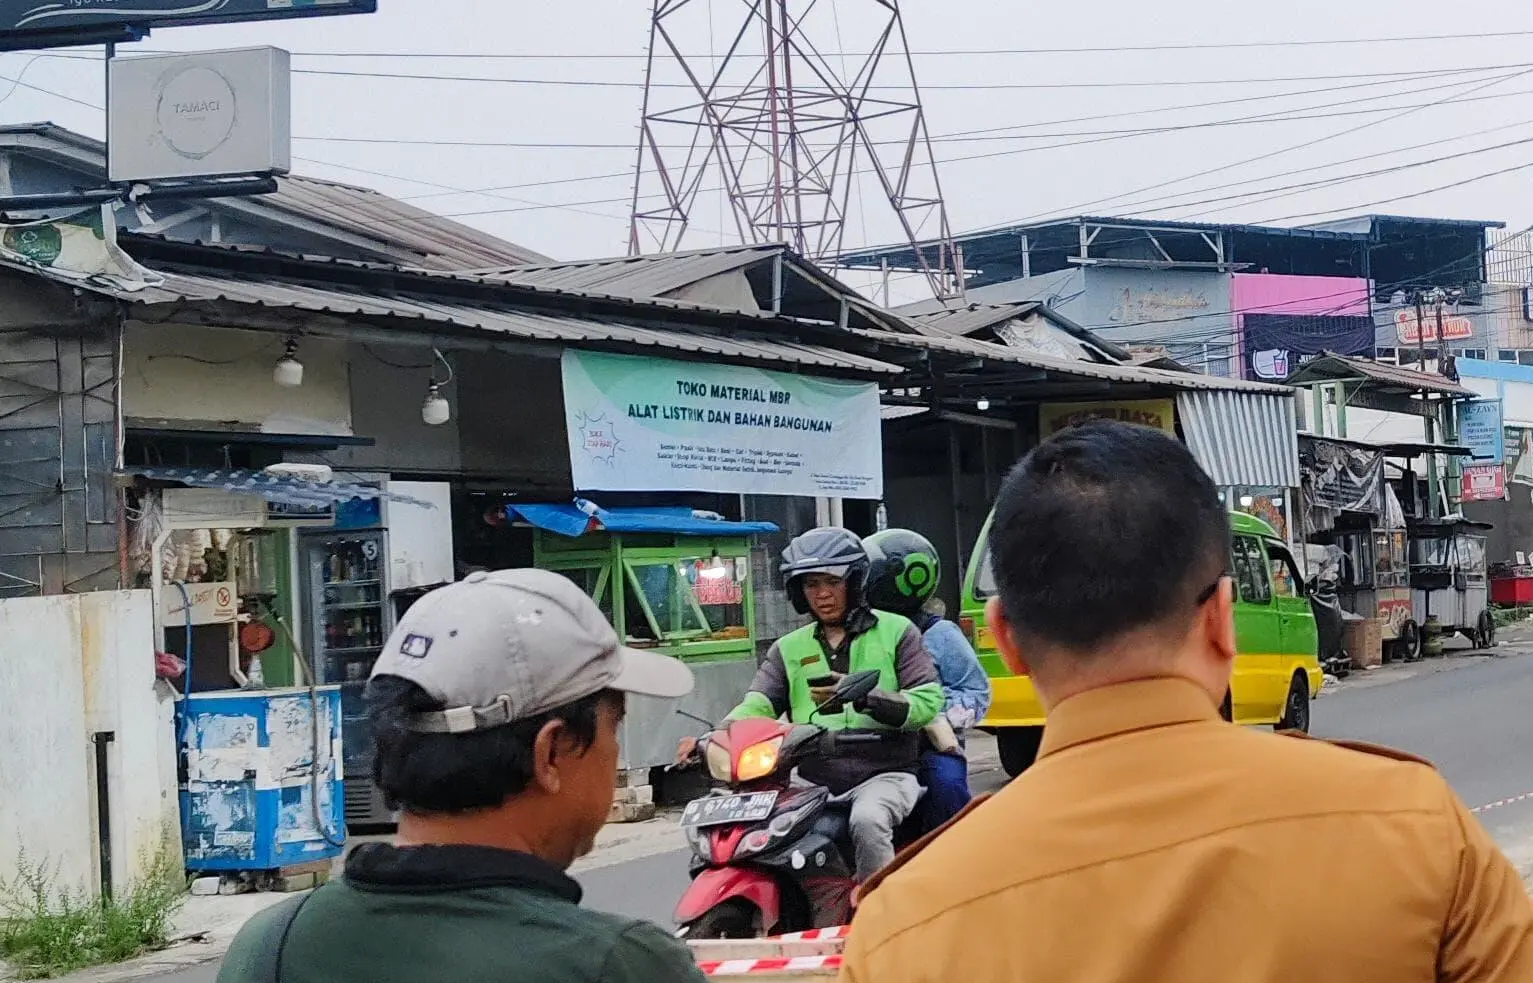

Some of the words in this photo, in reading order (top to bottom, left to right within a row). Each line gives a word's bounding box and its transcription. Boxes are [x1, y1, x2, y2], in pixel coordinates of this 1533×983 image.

[676, 380, 708, 397] TOKO
[710, 386, 766, 403] MATERIAL
[769, 391, 791, 405] MBR
[628, 404, 659, 419] ALAT
[663, 405, 705, 423] LISTRIK
[707, 410, 731, 424] DAN
[734, 412, 771, 428] BAHAN
[773, 415, 833, 434] BANGUNAN
